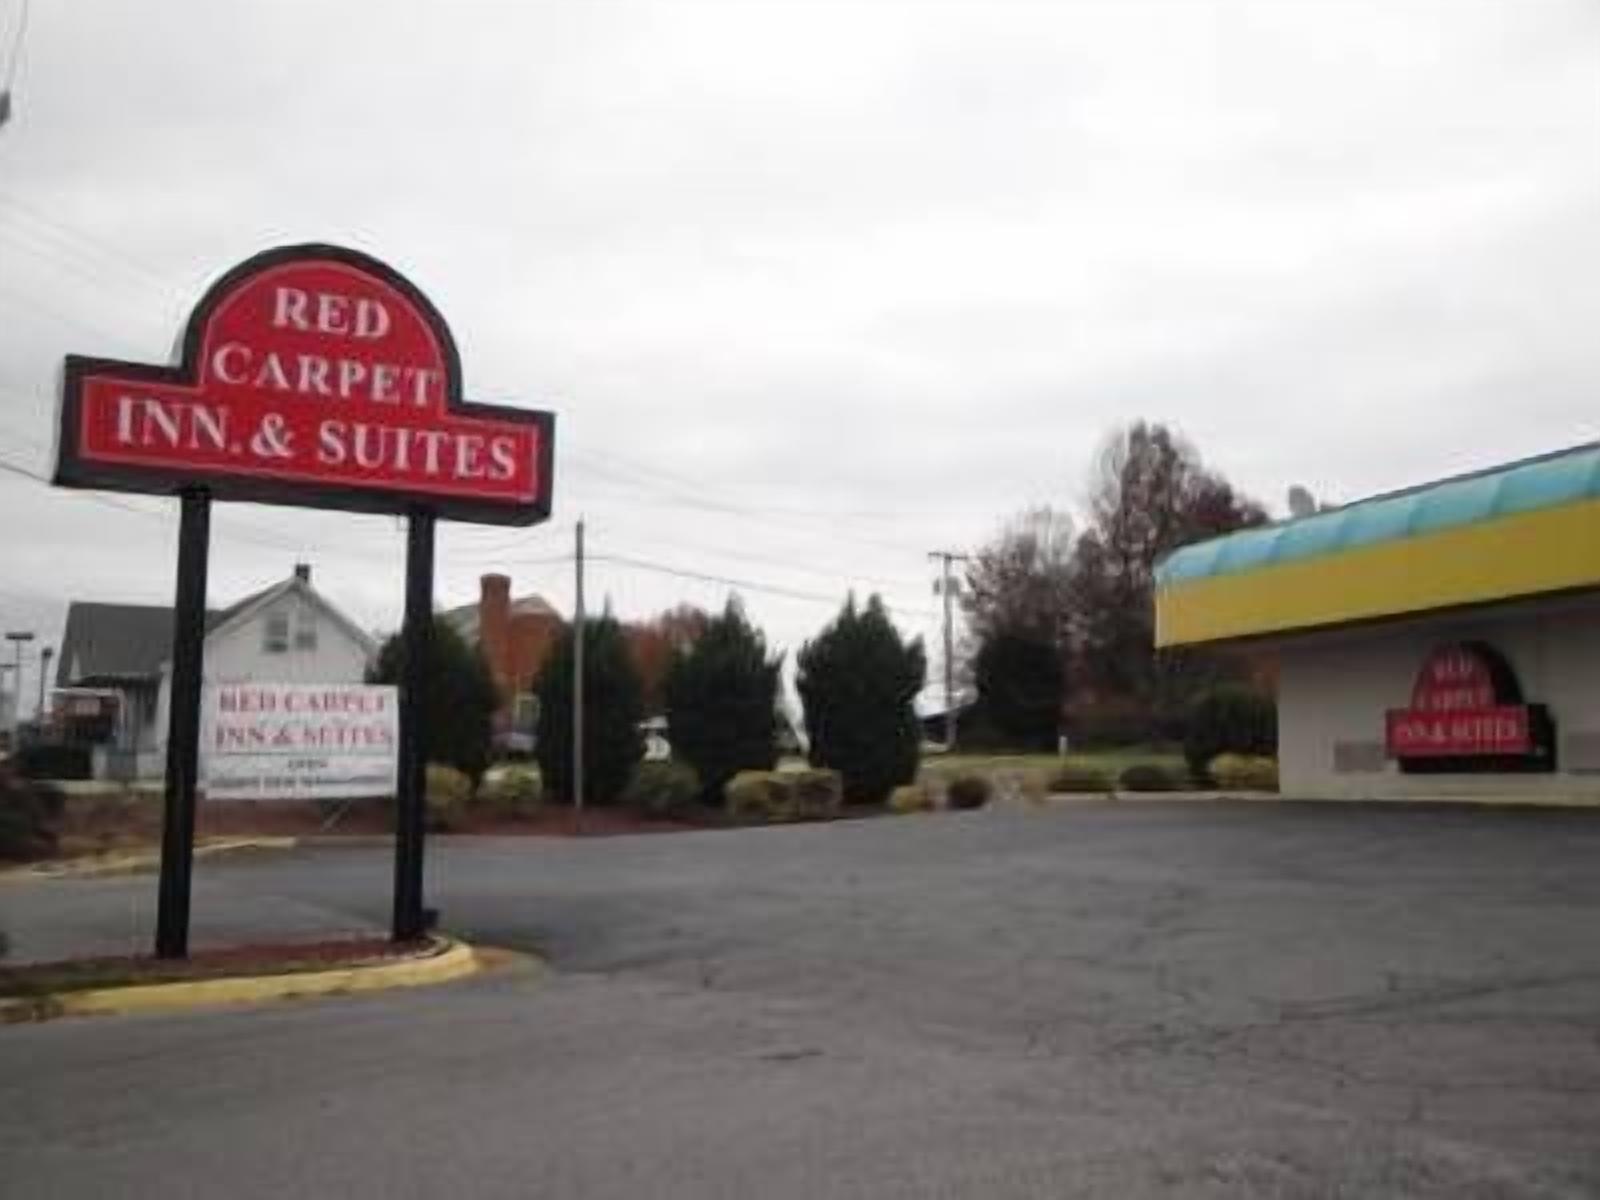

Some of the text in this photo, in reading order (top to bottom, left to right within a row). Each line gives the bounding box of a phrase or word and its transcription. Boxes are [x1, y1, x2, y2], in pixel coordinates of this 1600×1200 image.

[273, 286, 391, 339] RED
[212, 343, 440, 408] CARPET
[250, 412, 295, 459] &
[318, 420, 518, 481] SUITES
